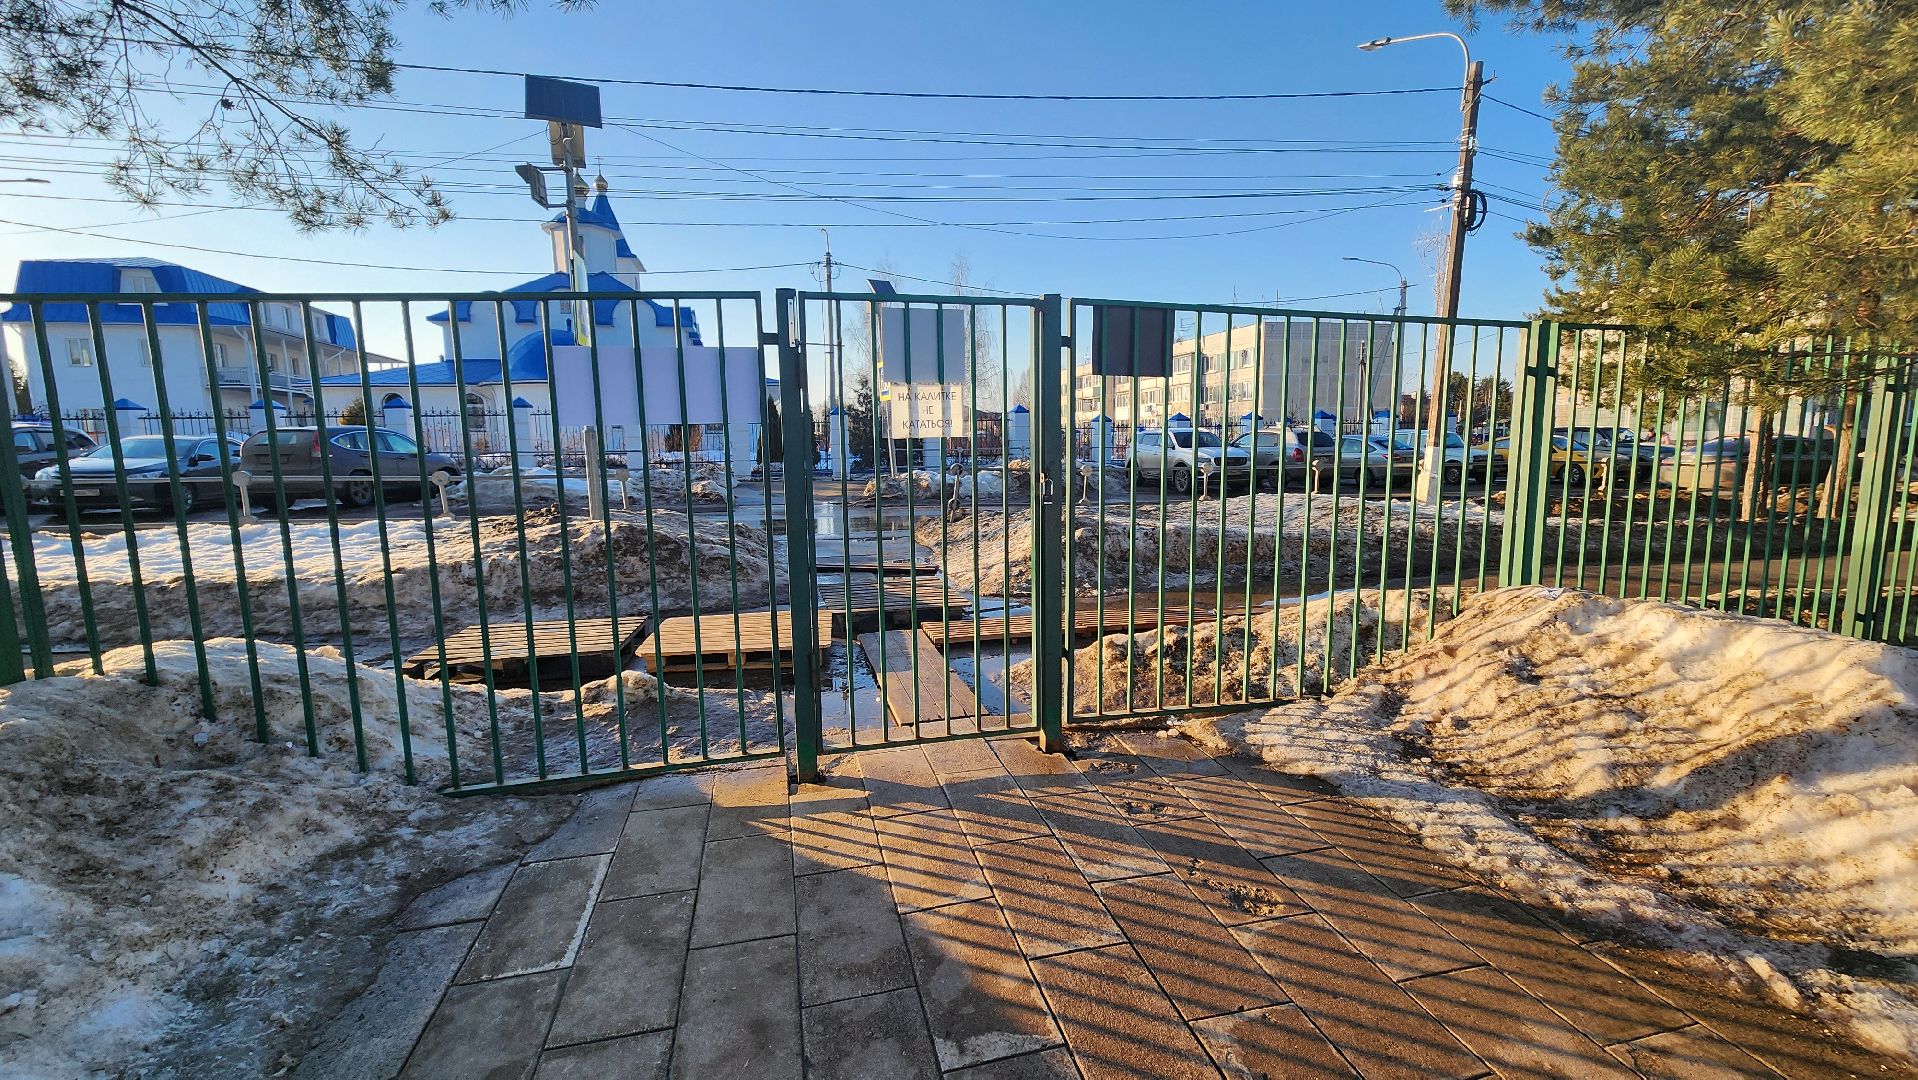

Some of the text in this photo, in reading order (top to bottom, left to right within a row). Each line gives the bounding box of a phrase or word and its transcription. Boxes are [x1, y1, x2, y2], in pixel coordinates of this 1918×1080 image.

[898, 391, 957, 401] НА КАЛИТКЕ
[922, 405, 934, 415] НЕ
[902, 419, 953, 429] КАТАТЬСЯ!
